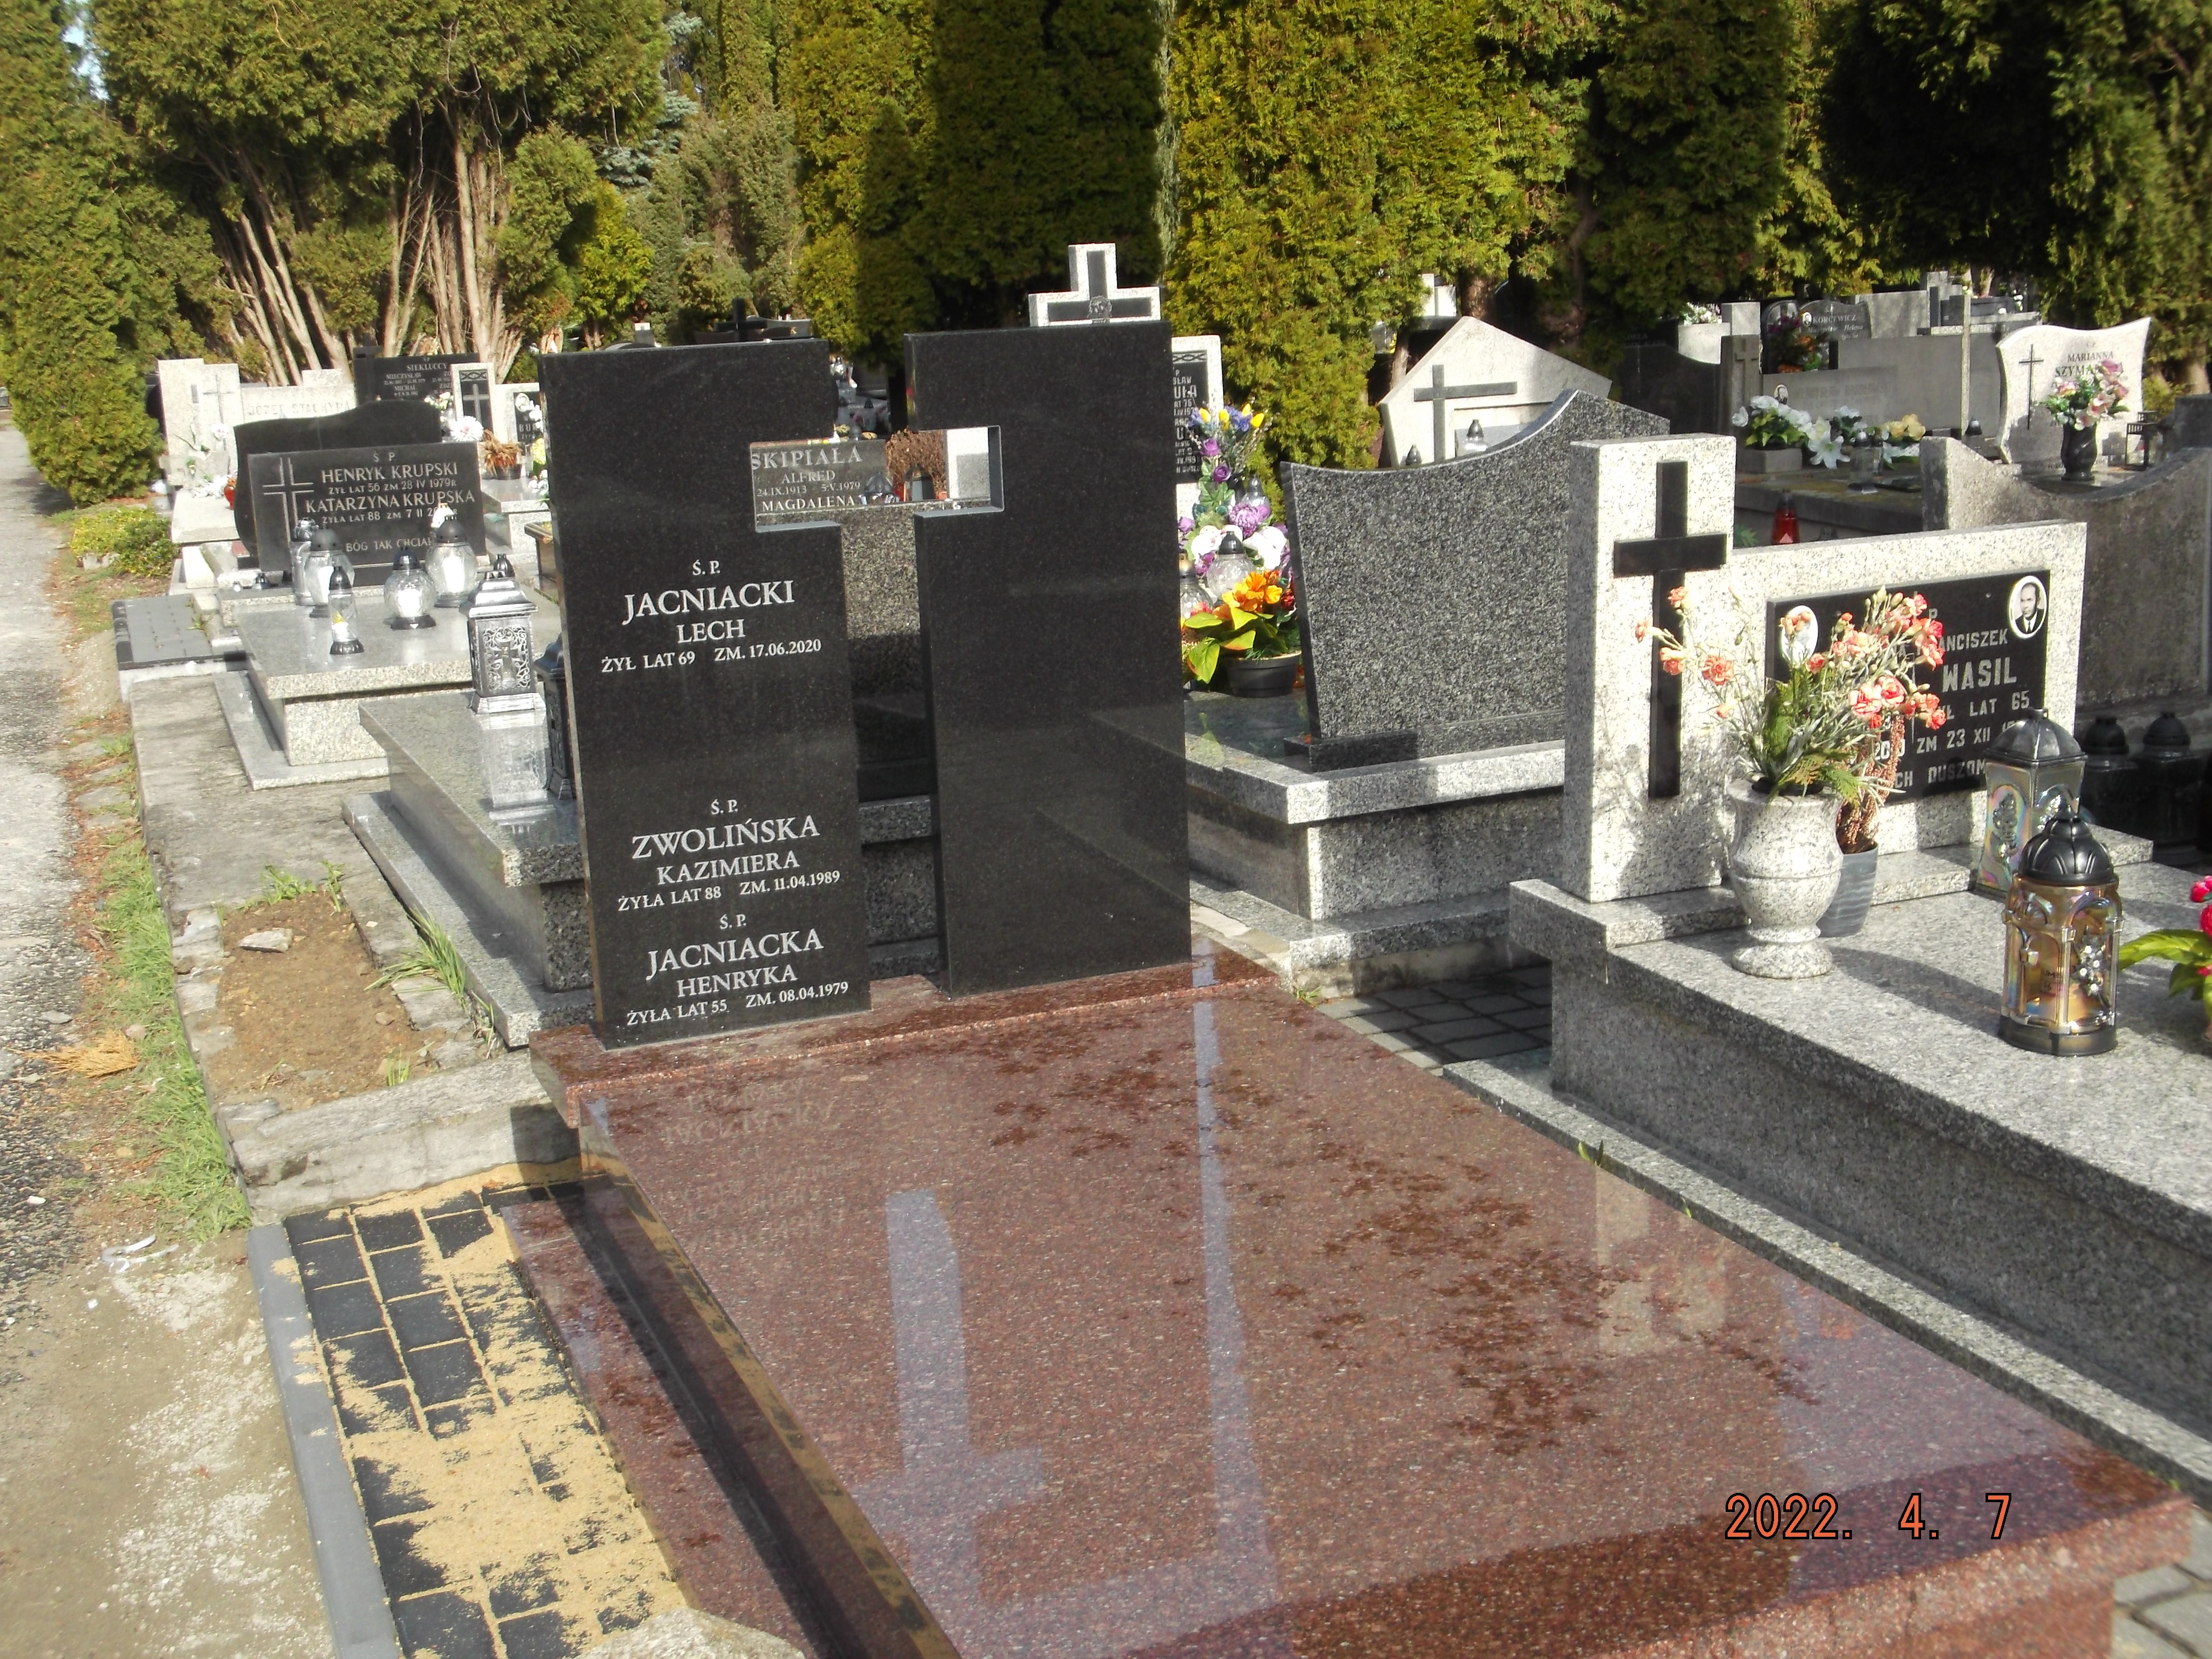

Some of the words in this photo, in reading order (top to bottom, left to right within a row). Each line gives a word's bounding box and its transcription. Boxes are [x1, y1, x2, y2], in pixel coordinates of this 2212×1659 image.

[2068, 351, 2113, 362] MARIANNA
[752, 445, 863, 470] SKIPIAŁA
[321, 466, 386, 483] HENRYK
[392, 462, 458, 479] KRUPSKI
[782, 470, 836, 484] ALFRED
[349, 485, 365, 493] LAT
[368, 482, 381, 492] 56
[401, 480, 413, 490] 28
[416, 479, 426, 489] IV
[305, 494, 400, 513] KATARZYNA
[403, 490, 476, 507] KRUPSKA
[762, 495, 855, 512] MAGDALENA
[368, 511, 381, 521] 88
[407, 509, 412, 518] 7
[346, 540, 368, 552] BÓG
[374, 540, 392, 549] TAK
[692, 559, 706, 576] Ś.
[709, 560, 721, 575] P.
[622, 580, 795, 626] JACNIACKI
[676, 619, 746, 644] LECH
[601, 656, 637, 673] ŻYŁ
[643, 652, 675, 669] LAT
[678, 650, 695, 665] 69
[714, 646, 746, 661] ZM.
[749, 639, 822, 658] 17.06.2020
[1942, 657, 2018, 693] WASIL
[1970, 698, 1997, 717] LAT
[2012, 691, 2030, 711] 65
[1916, 736, 1938, 754] ZM
[1947, 728, 1965, 749] 23
[1973, 727, 1991, 744] XII
[1928, 758, 1986, 784] DUSZOM
[711, 799, 724, 815] Ś.
[727, 799, 738, 813] P.
[631, 815, 821, 859] ZWOLIŃSKA
[657, 851, 801, 885] KAZIMIERA
[618, 893, 665, 912] ŻYŁA
[670, 888, 702, 904] LAT
[705, 886, 722, 900] 88
[739, 879, 771, 896] ZM.
[774, 870, 840, 891] 11.04.1989
[720, 914, 733, 930] Ś.
[736, 914, 747, 928] P.
[646, 928, 824, 981] JACNIACKA
[677, 965, 798, 998] HENRYKA
[627, 1007, 672, 1026] ŻYŁA
[677, 1001, 708, 1018] LAT
[711, 999, 727, 1013] 55
[745, 993, 776, 1008] ZM.
[779, 981, 849, 1002] 08.04.1979
